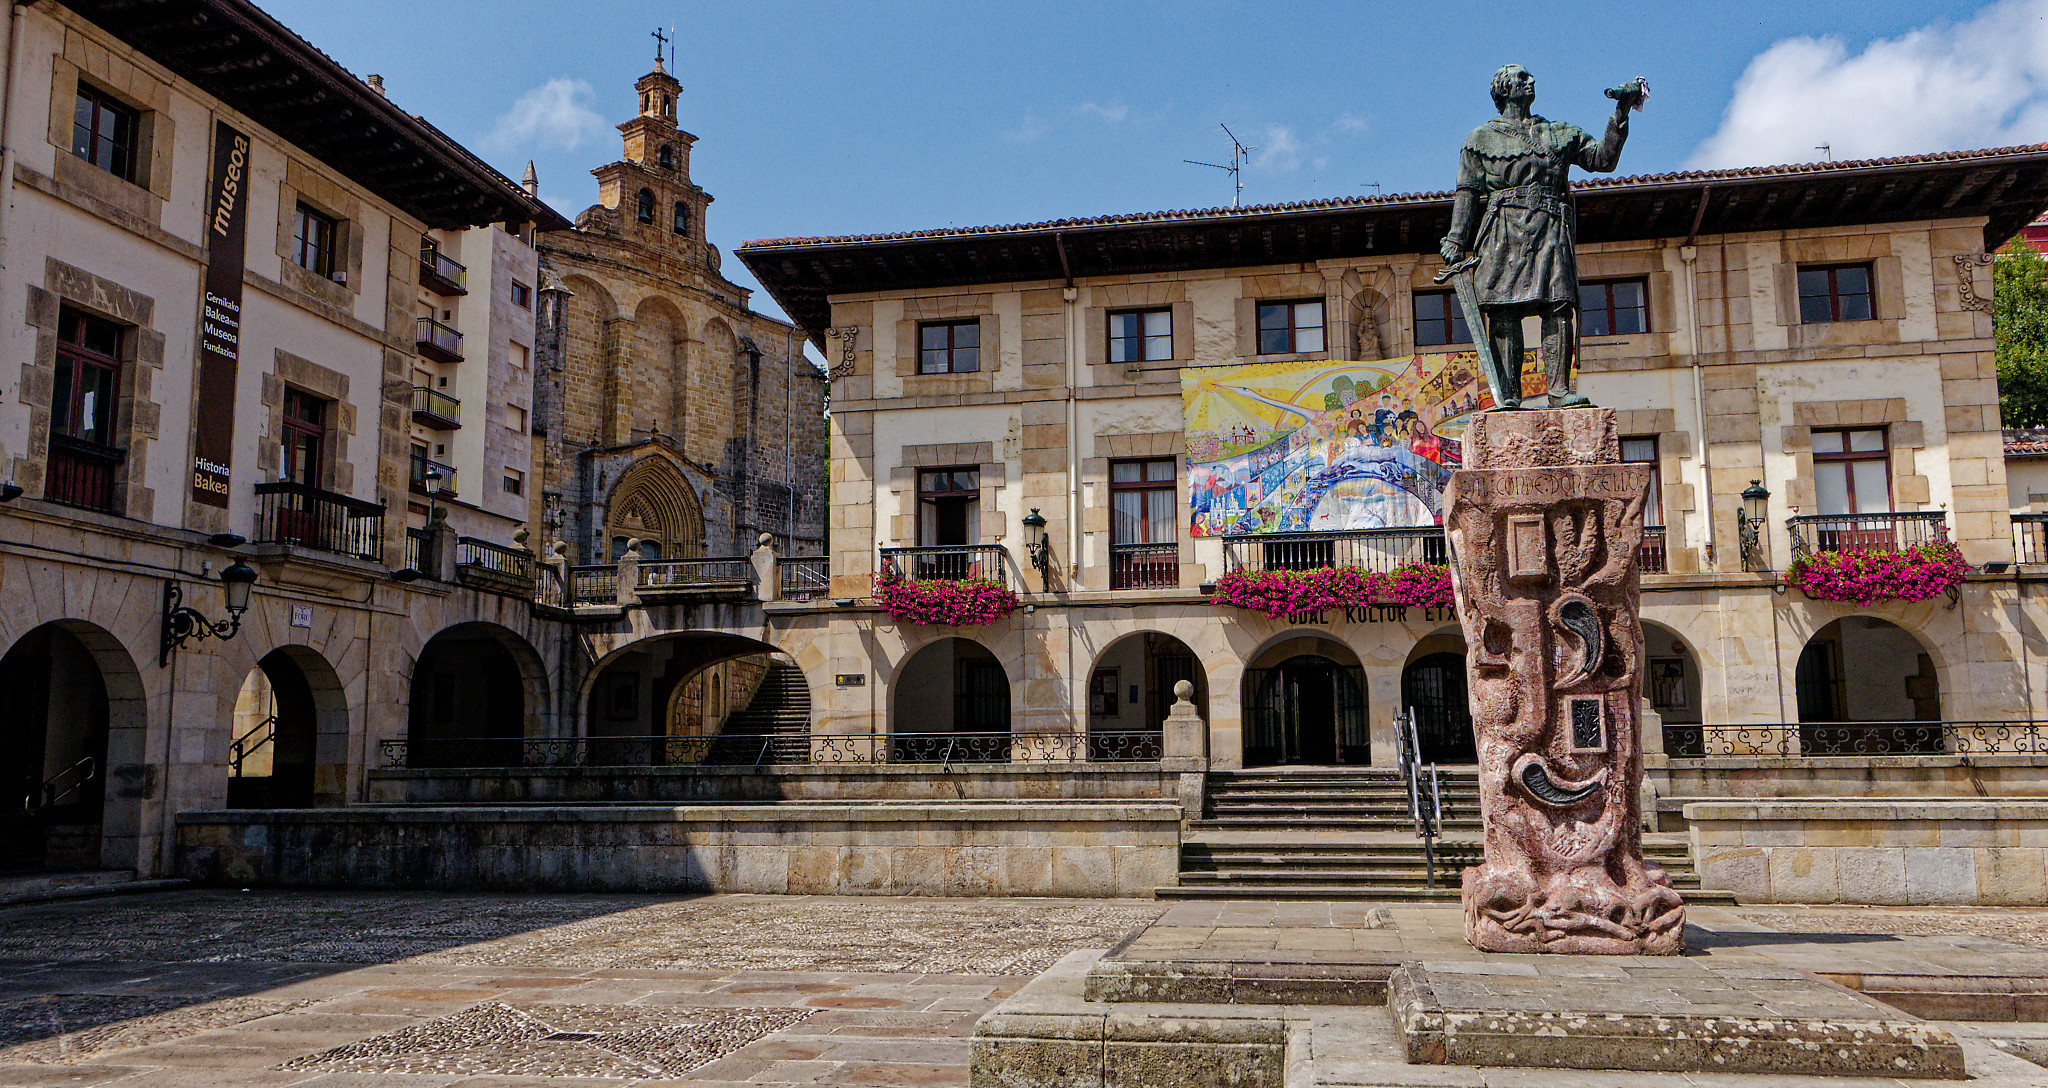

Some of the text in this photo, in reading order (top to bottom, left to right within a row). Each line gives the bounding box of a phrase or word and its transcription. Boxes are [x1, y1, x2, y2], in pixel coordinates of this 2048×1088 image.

[213, 135, 248, 237] museoa
[204, 321, 237, 344] Museoa
[203, 339, 237, 360] Fundazioa
[195, 456, 230, 476] Historia
[194, 472, 228, 495] Bakea
[1288, 607, 1329, 625] UDAL
[1345, 604, 1407, 624] KULTUR
